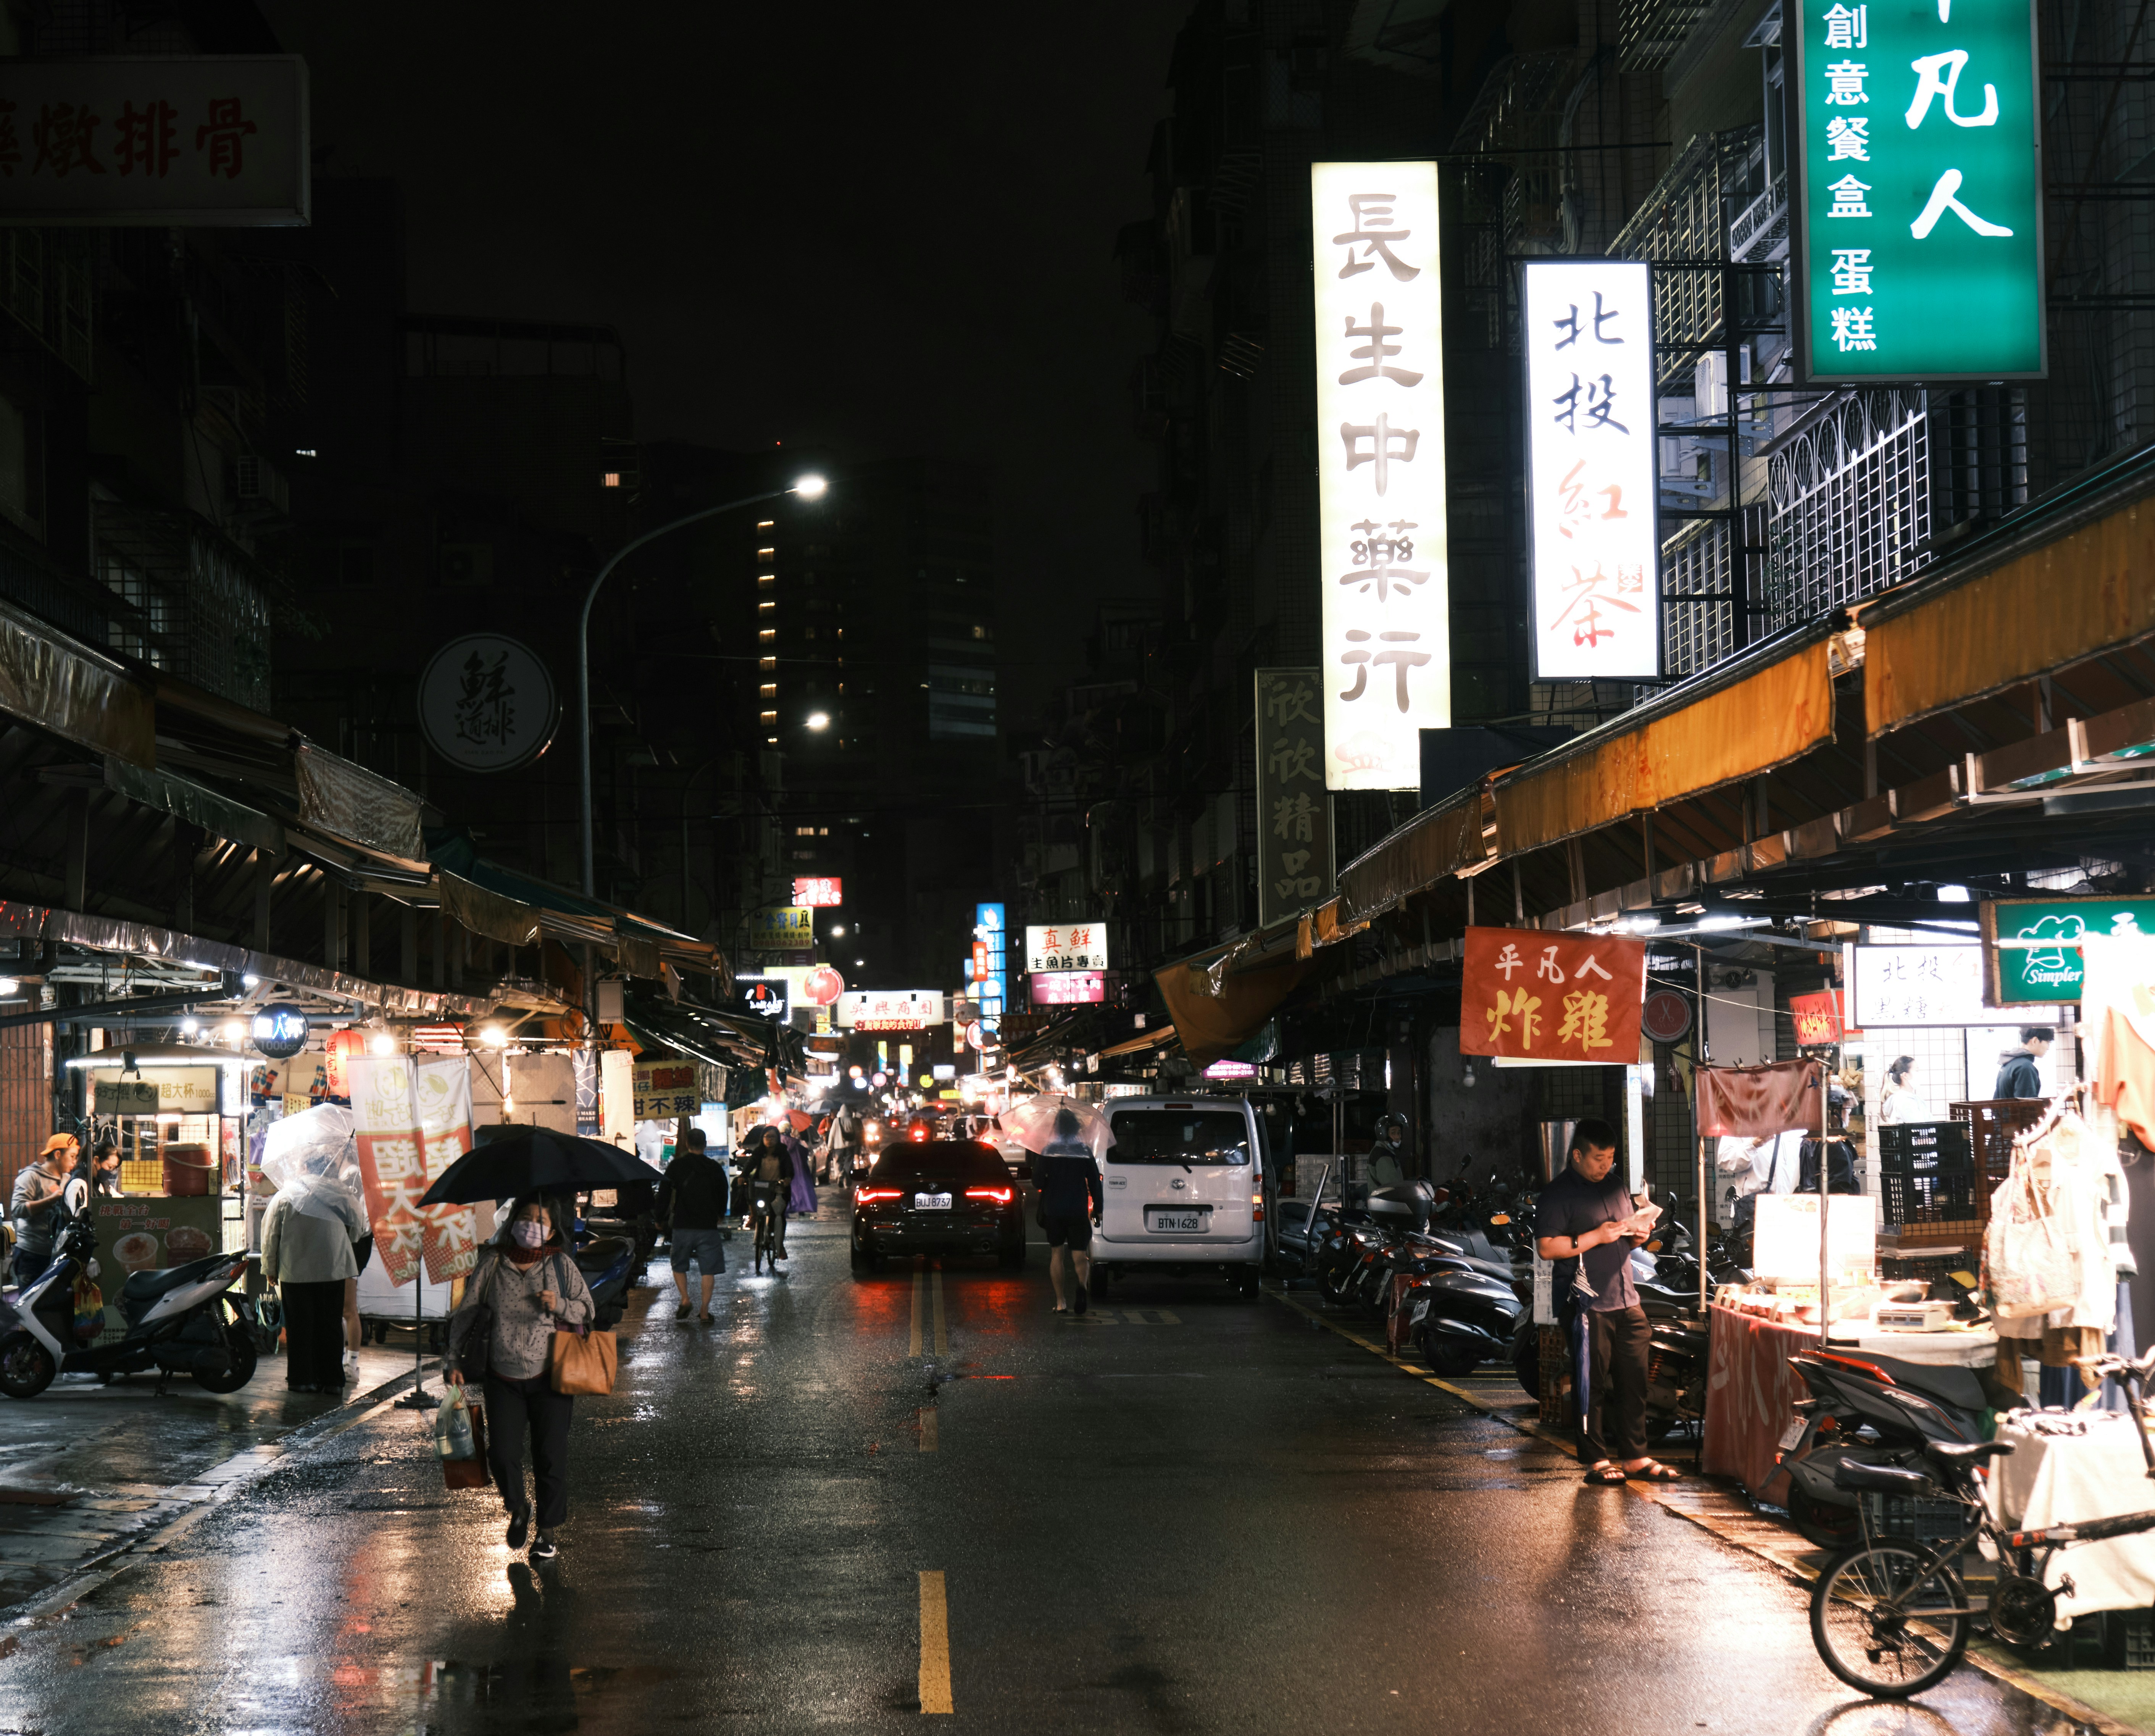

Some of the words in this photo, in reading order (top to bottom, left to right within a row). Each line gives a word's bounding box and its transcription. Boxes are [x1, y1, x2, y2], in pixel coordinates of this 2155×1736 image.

[1823, 3, 1872, 218] 創意餐盒
[1905, 0, 2013, 239] 凡人
[1830, 249, 1877, 352] 蛋糕
[1332, 194, 1432, 714] 長生中藥行
[1550, 291, 1642, 649] 北投紅茶
[1267, 680, 1321, 899] 欣欣精品
[1041, 928, 1092, 954] 真鮮
[1031, 955, 1104, 969] 生魚片專賣
[1494, 943, 1613, 984] 平凡人
[2027, 966, 2083, 987] Simpler
[1486, 986, 1613, 1053] 炸雞
[261, 1041, 297, 1050] 1000cc
[160, 1083, 194, 1099] 超大杯
[99, 1204, 150, 1216] 挑戰全台
[119, 1218, 171, 1230] 第一好喝
